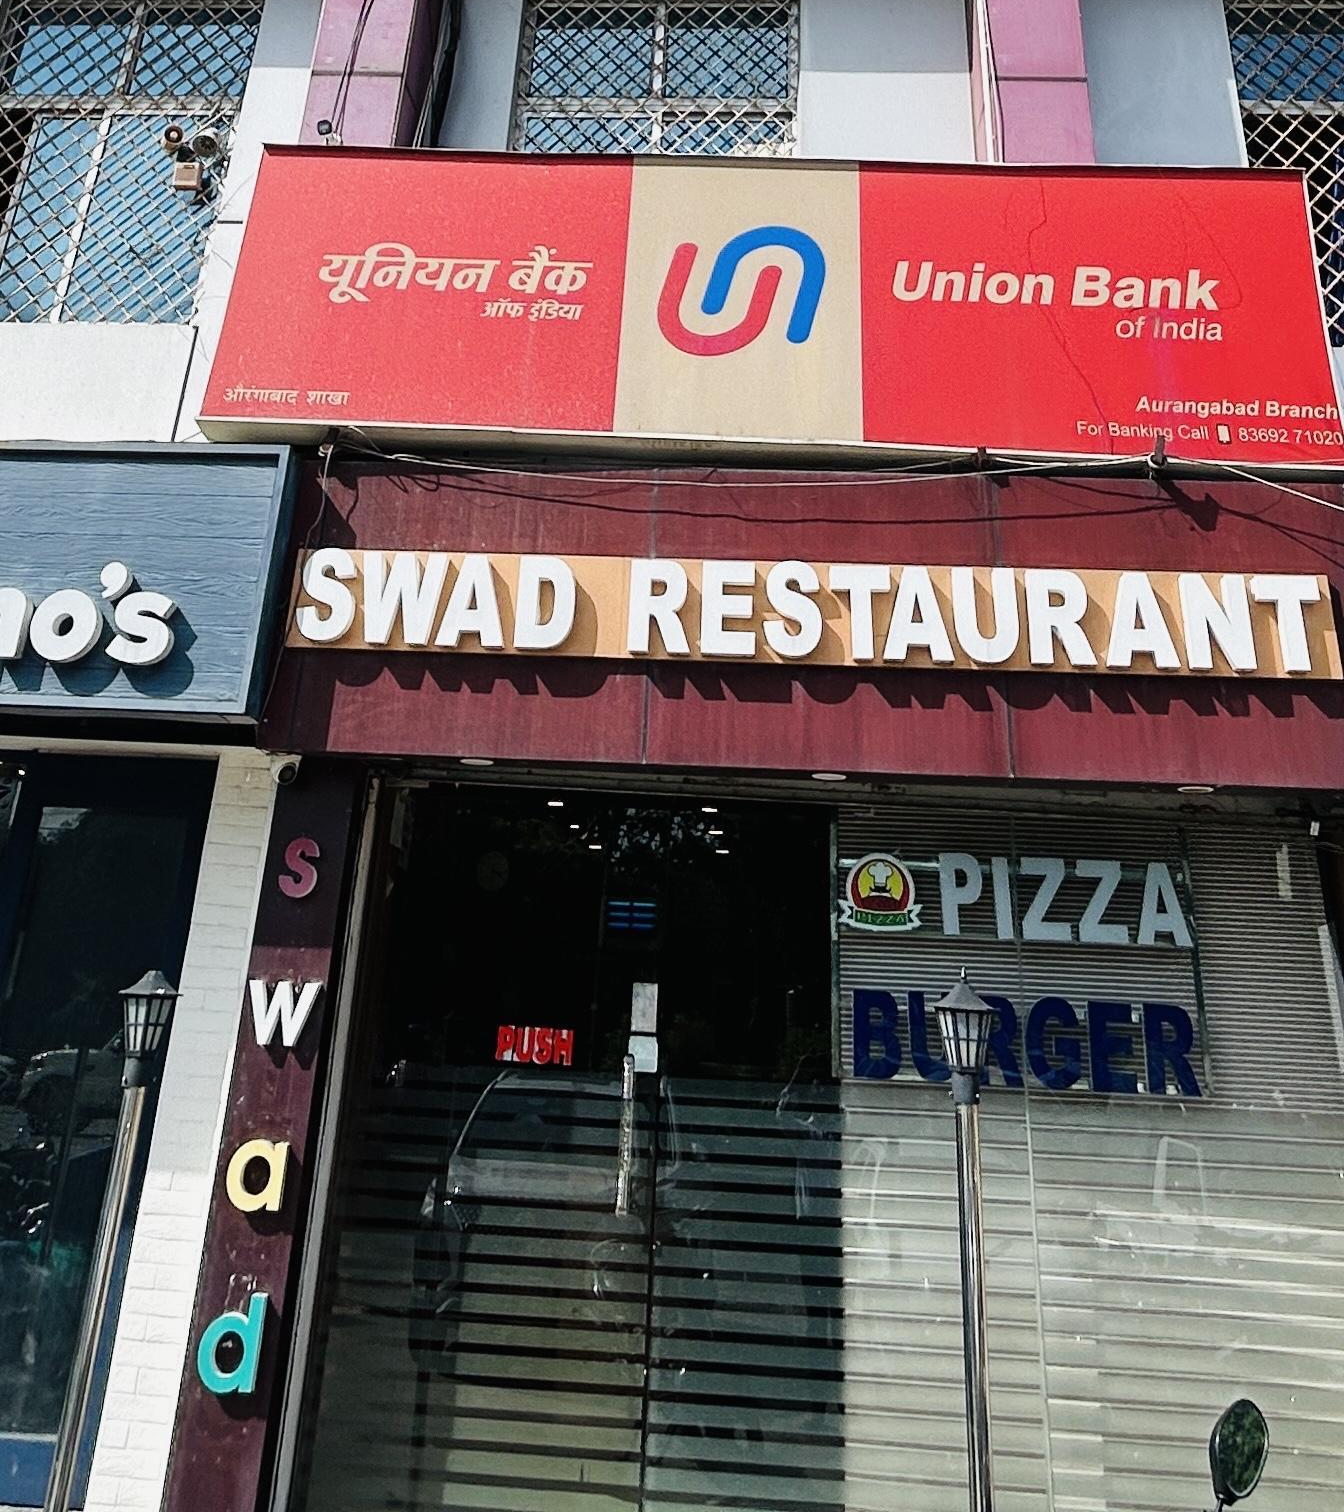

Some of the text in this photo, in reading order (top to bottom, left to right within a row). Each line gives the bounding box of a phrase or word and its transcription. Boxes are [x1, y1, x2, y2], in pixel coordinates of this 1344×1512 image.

[319, 242, 593, 303] यूनियन बैंक
[892, 260, 1221, 311] Union Bank
[481, 300, 583, 322] ऑफ इंडिया
[1115, 316, 1224, 341] of India
[223, 383, 350, 406] औरंगाबाद शाखा
[1135, 395, 1338, 420] Aurangabad Branch
[1076, 420, 1344, 446] For Banking Call 83692 71020
[295, 547, 1321, 674] SWAD RESTAURANT
[938, 852, 1194, 948] PIZZA
[494, 1024, 574, 1066] PUSH
[852, 989, 1204, 1098] BURGER
